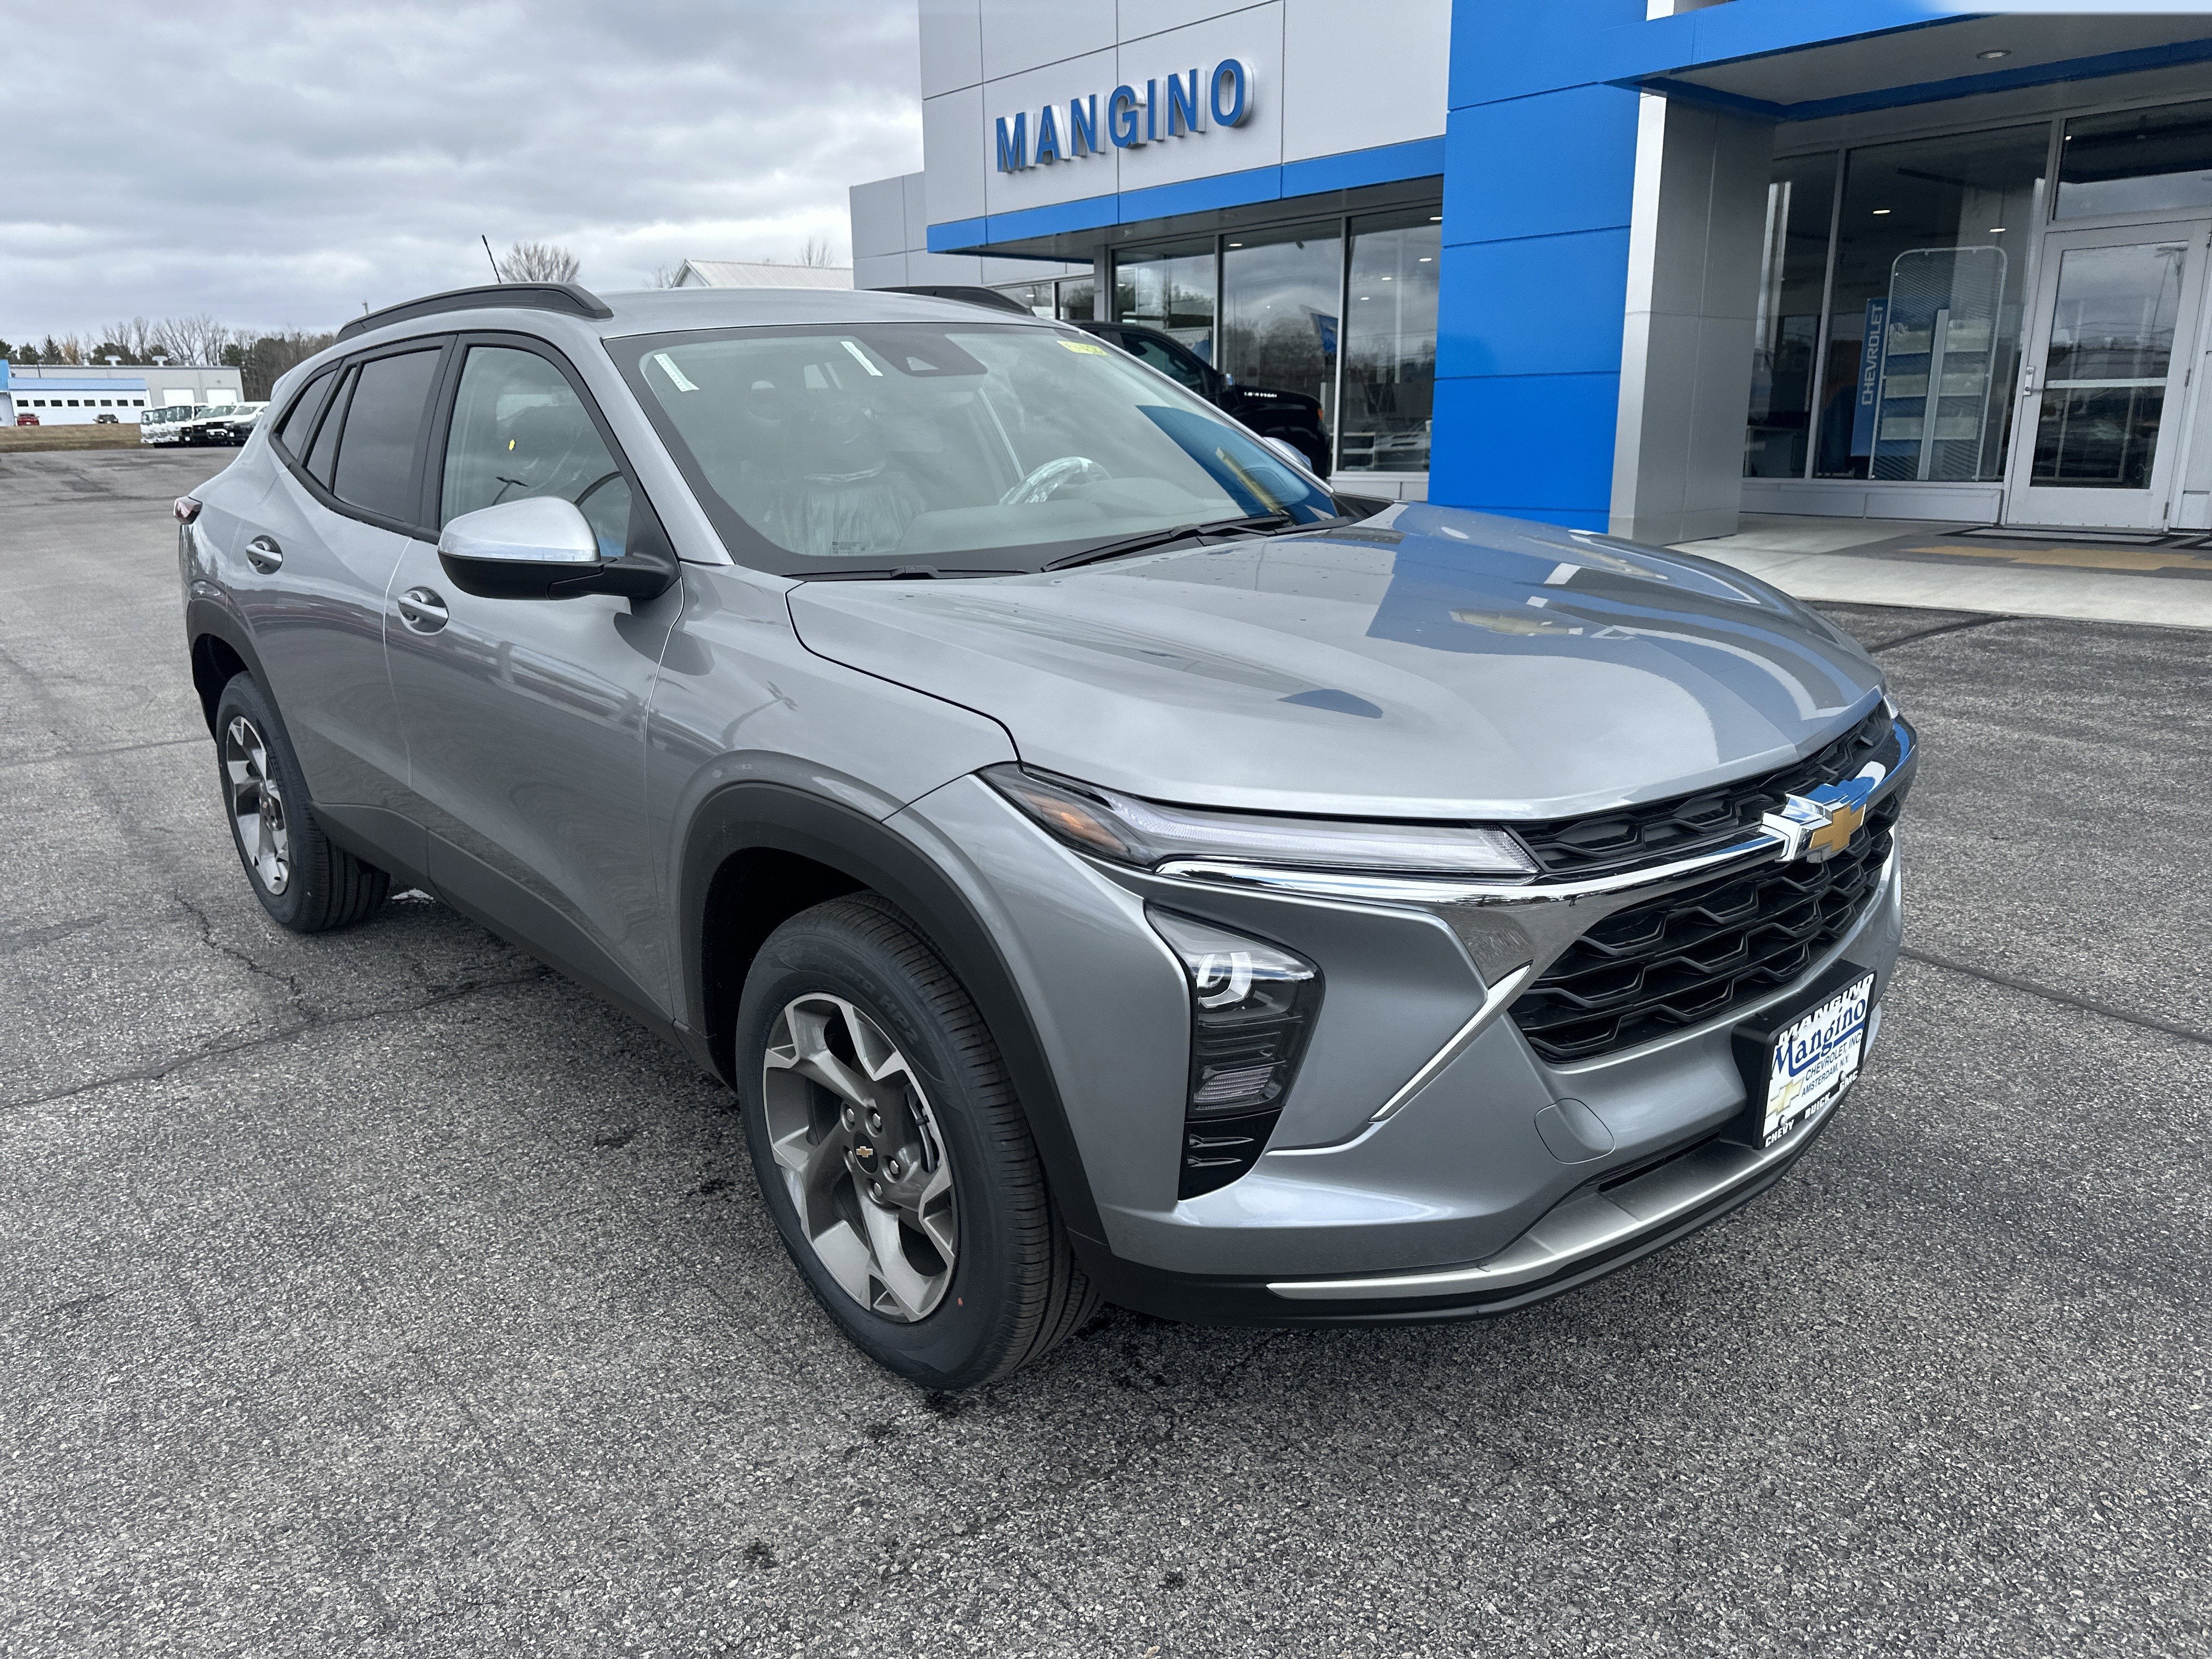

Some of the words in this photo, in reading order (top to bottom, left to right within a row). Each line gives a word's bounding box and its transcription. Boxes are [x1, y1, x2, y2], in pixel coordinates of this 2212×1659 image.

[996, 58, 1250, 173] MANGINO
[1861, 304, 1883, 405] CHEVROLET
[1772, 999, 1865, 1077] Mangino
[1778, 974, 1874, 1045] MANGINO
[1765, 1119, 1794, 1148] CHEVY
[1804, 1092, 1831, 1119] BUICK
